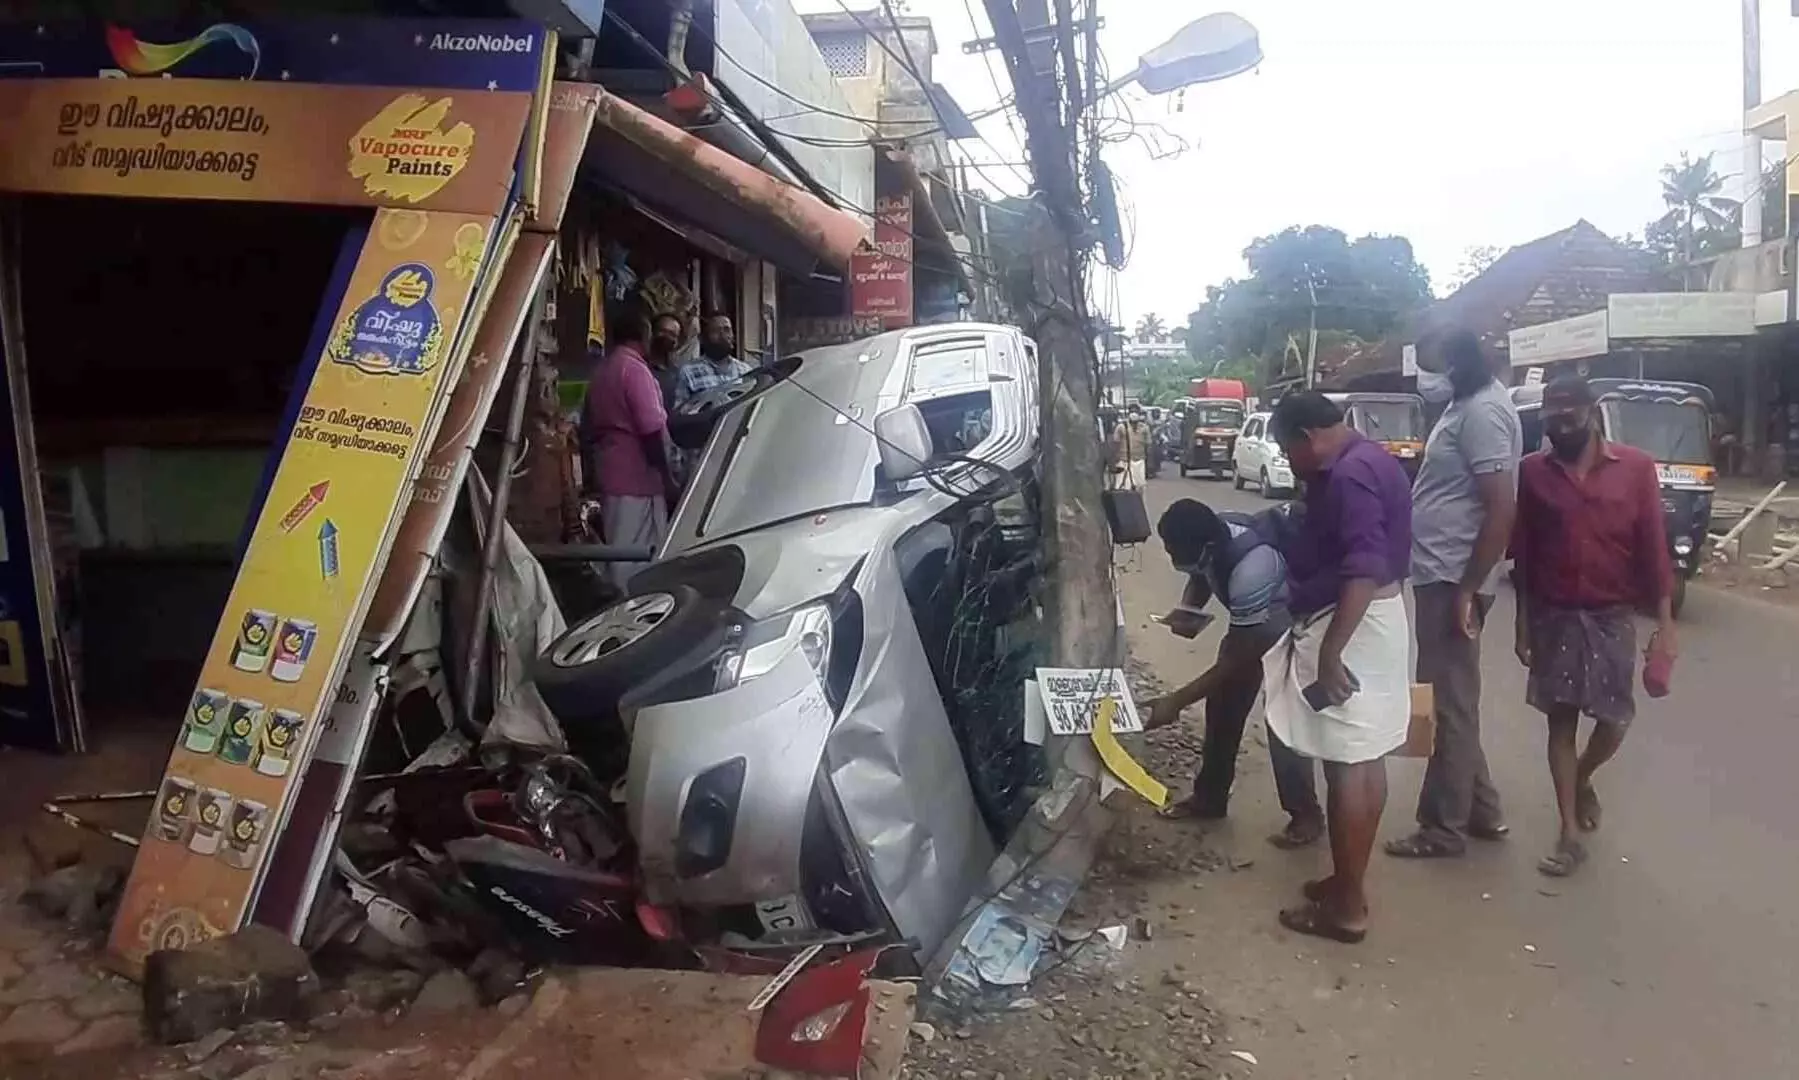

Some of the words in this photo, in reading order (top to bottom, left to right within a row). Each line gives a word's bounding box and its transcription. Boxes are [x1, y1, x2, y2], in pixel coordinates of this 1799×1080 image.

[429, 32, 533, 53] AkzoNobel
[57, 103, 100, 136] ഈ
[107, 96, 270, 138] വിഷുക്കാലം,
[358, 137, 459, 158] Vapocure
[385, 157, 453, 177] Paints
[365, 310, 424, 338] വിഷു
[299, 405, 326, 424] ഈ
[328, 408, 415, 438] വിഷുക്കാലം,
